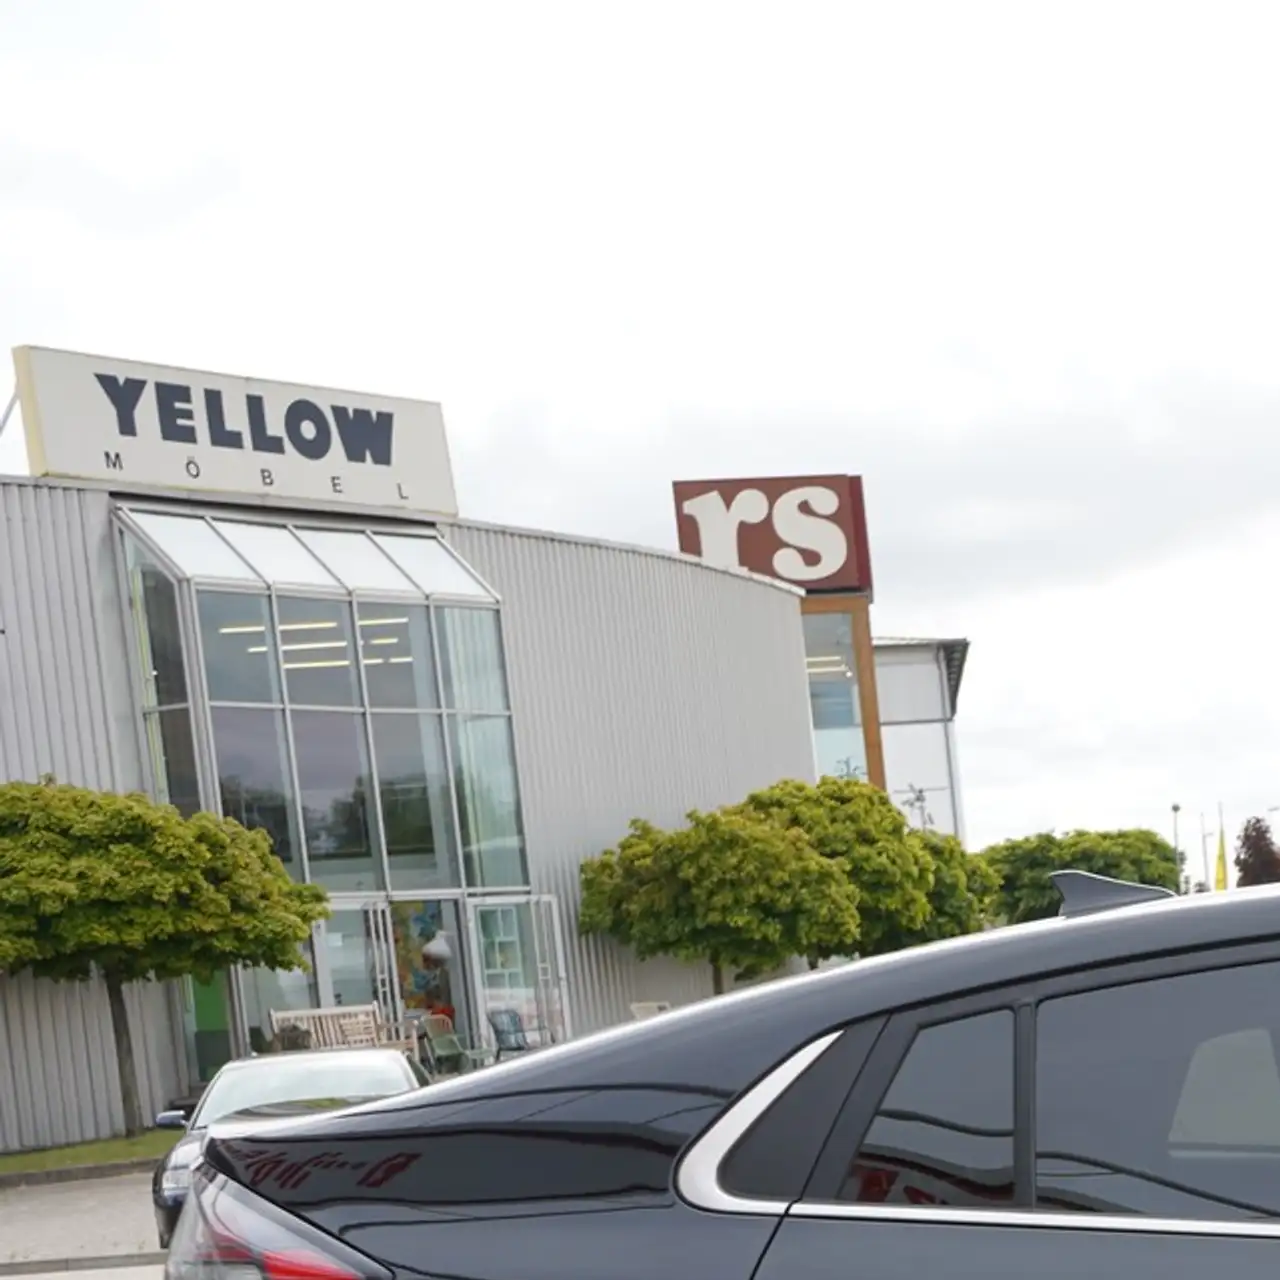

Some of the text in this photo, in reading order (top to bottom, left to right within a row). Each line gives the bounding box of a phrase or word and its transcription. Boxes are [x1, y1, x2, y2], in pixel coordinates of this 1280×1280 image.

[94, 373, 394, 466] YELLOW
[104, 451, 409, 500] MÖBEL
[682, 485, 847, 581] rs
